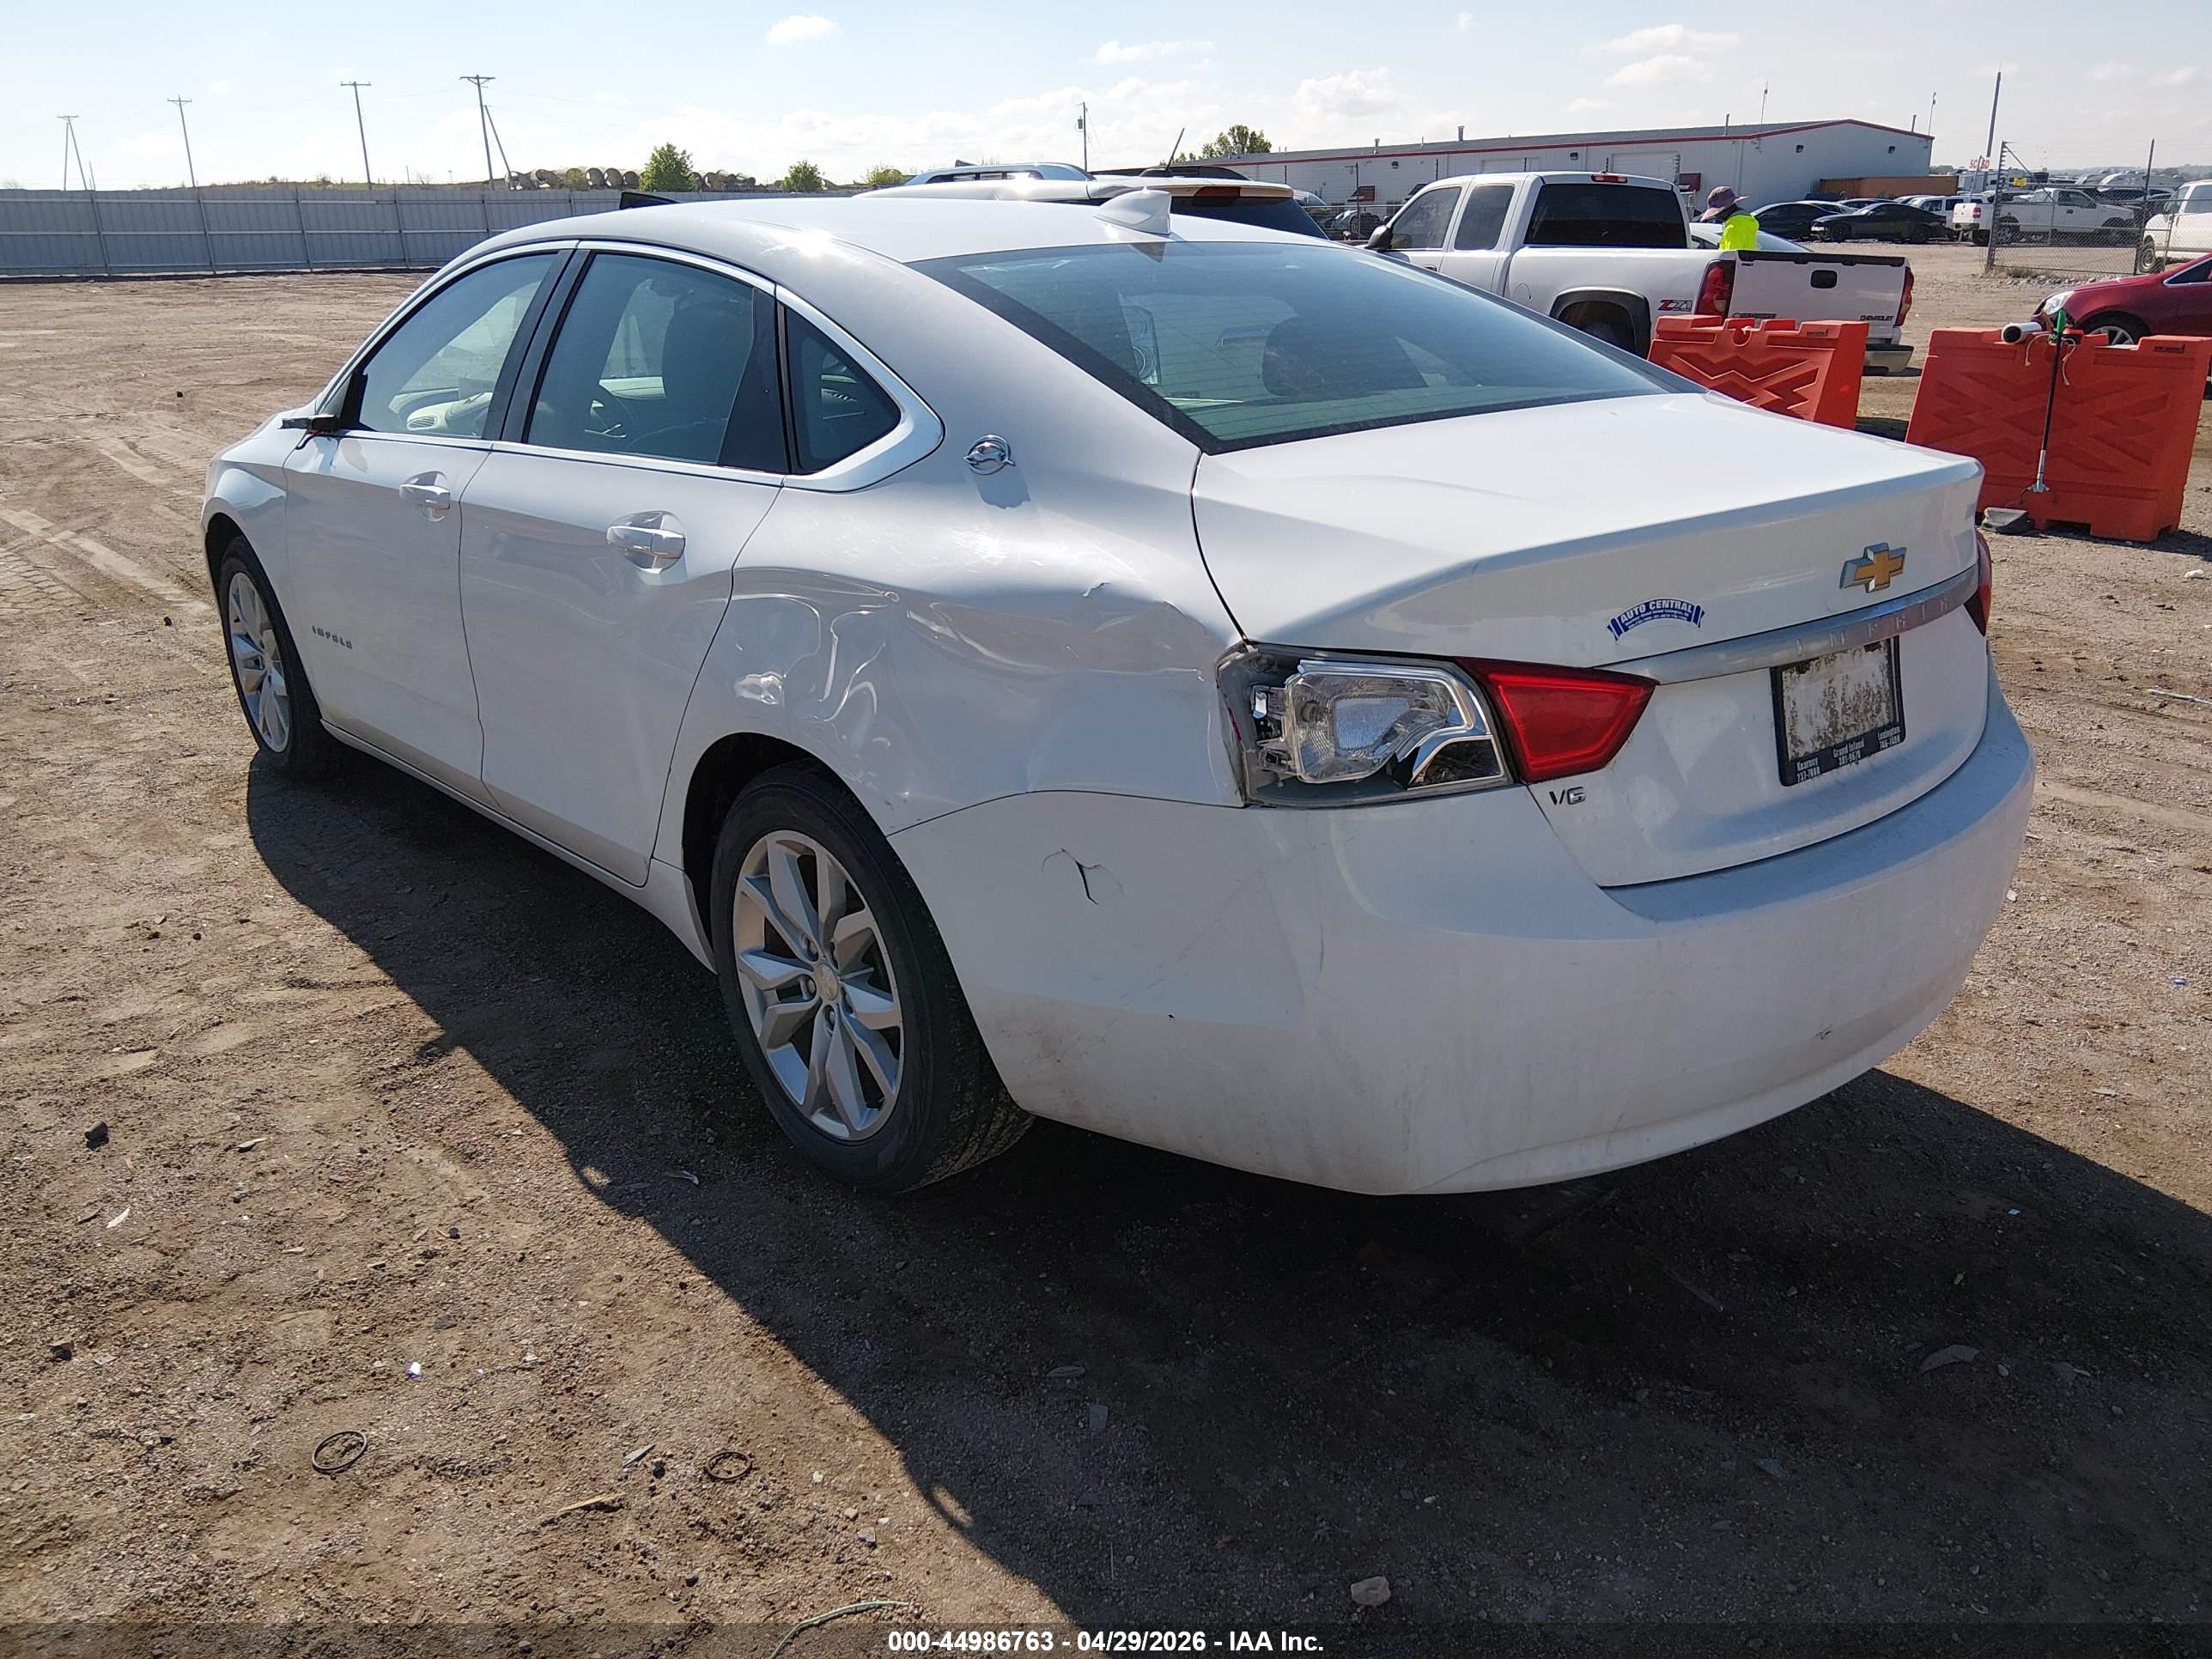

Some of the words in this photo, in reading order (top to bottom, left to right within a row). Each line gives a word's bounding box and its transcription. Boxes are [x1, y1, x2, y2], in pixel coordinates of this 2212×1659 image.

[1620, 604, 1646, 623] AUTO
[1649, 599, 1692, 613] CENTRAL
[1548, 786, 1586, 805] V6
